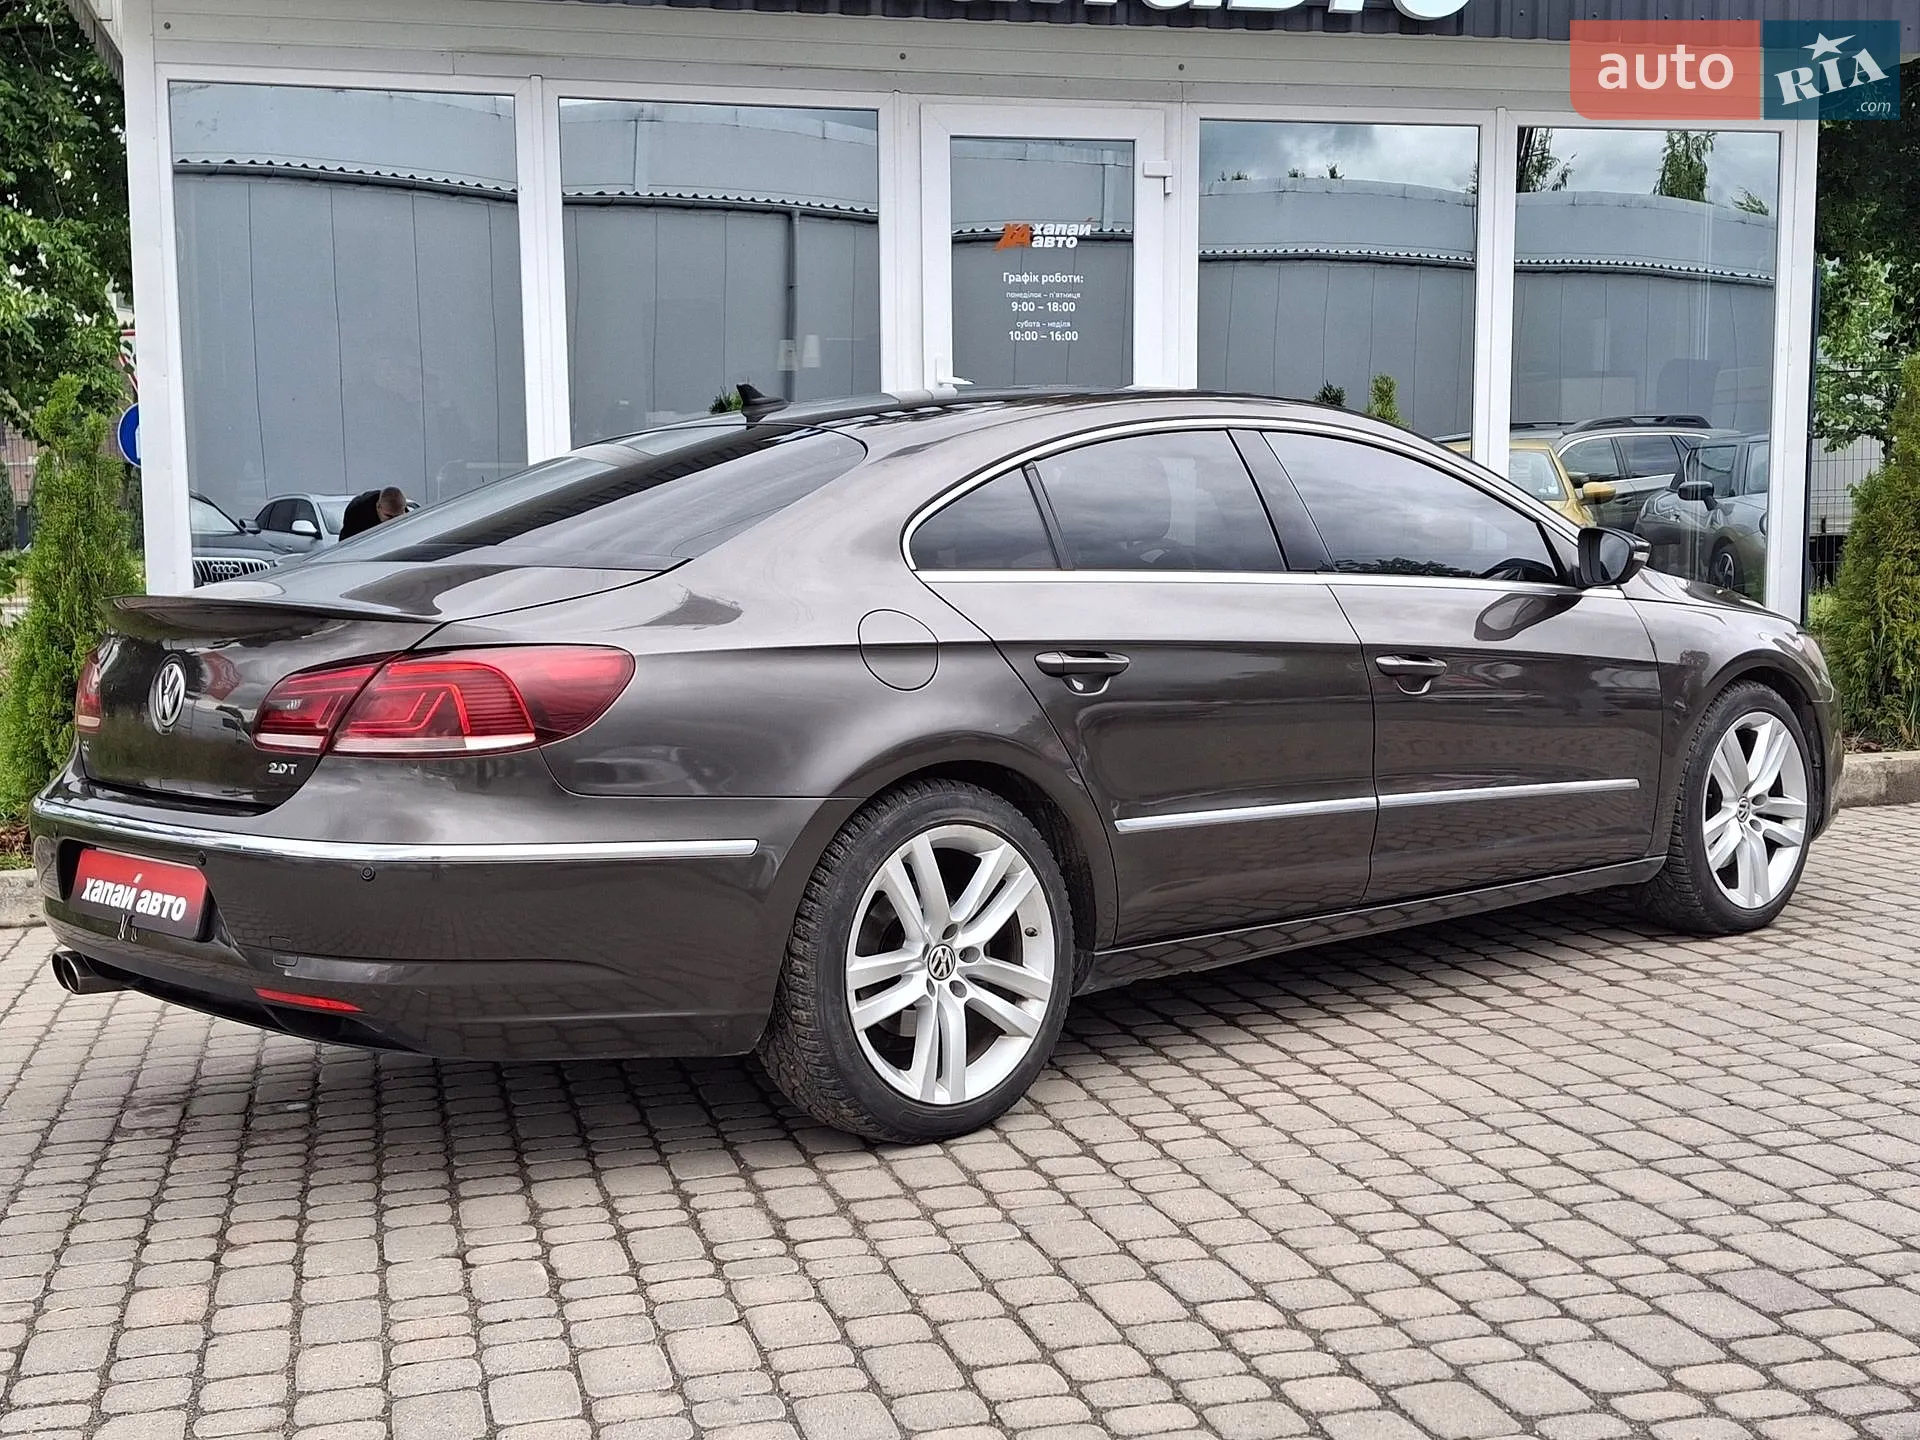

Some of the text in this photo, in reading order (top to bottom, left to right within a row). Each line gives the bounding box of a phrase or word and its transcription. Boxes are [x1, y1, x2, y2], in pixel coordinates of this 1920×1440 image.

[1031, 236, 1078, 248] авто
[1003, 272, 1084, 285] Графік роботи:
[1011, 301, 1035, 312] 9:00
[1046, 301, 1076, 312] 18:00
[1016, 320, 1040, 329] субота
[1009, 331, 1038, 341] 10:00
[1049, 331, 1079, 341] 16:00
[135, 889, 187, 921] авто
